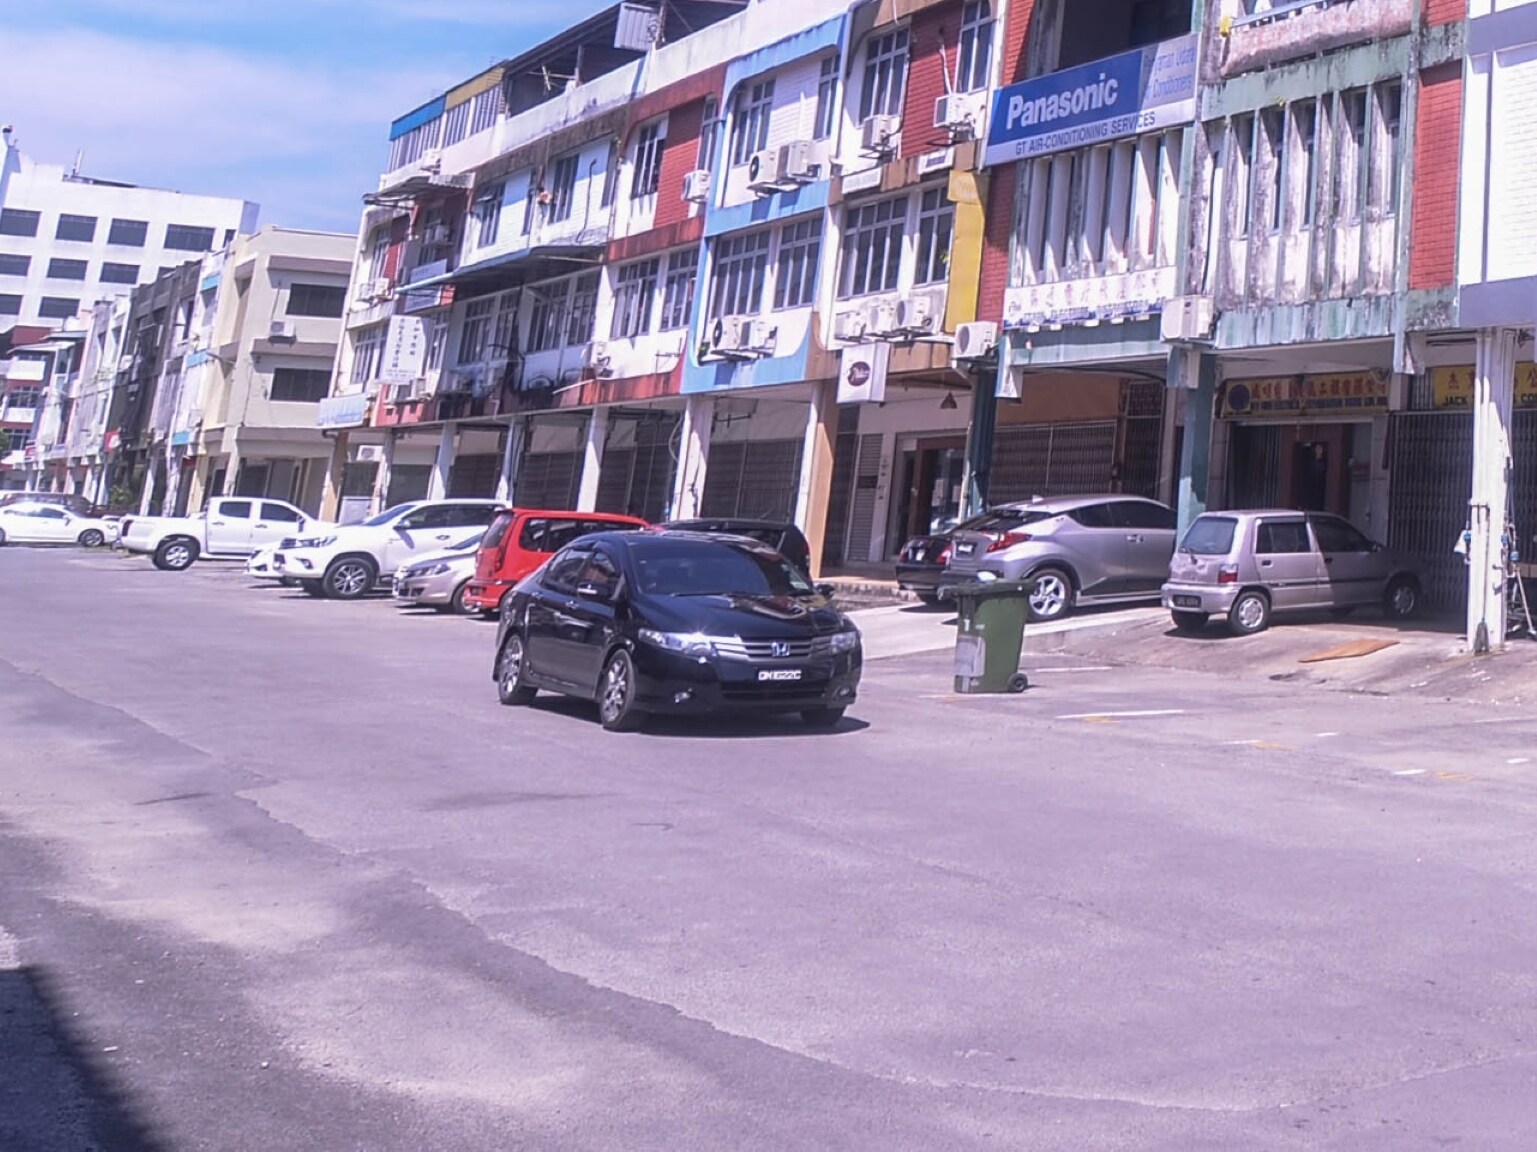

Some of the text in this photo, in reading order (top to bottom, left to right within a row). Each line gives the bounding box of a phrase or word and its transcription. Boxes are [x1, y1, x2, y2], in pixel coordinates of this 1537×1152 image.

[1006, 73, 1119, 130] Panasonic
[1016, 110, 1156, 155] GT AIR-CONDITIONING SERVICES
[1442, 396, 1468, 407] JACK
